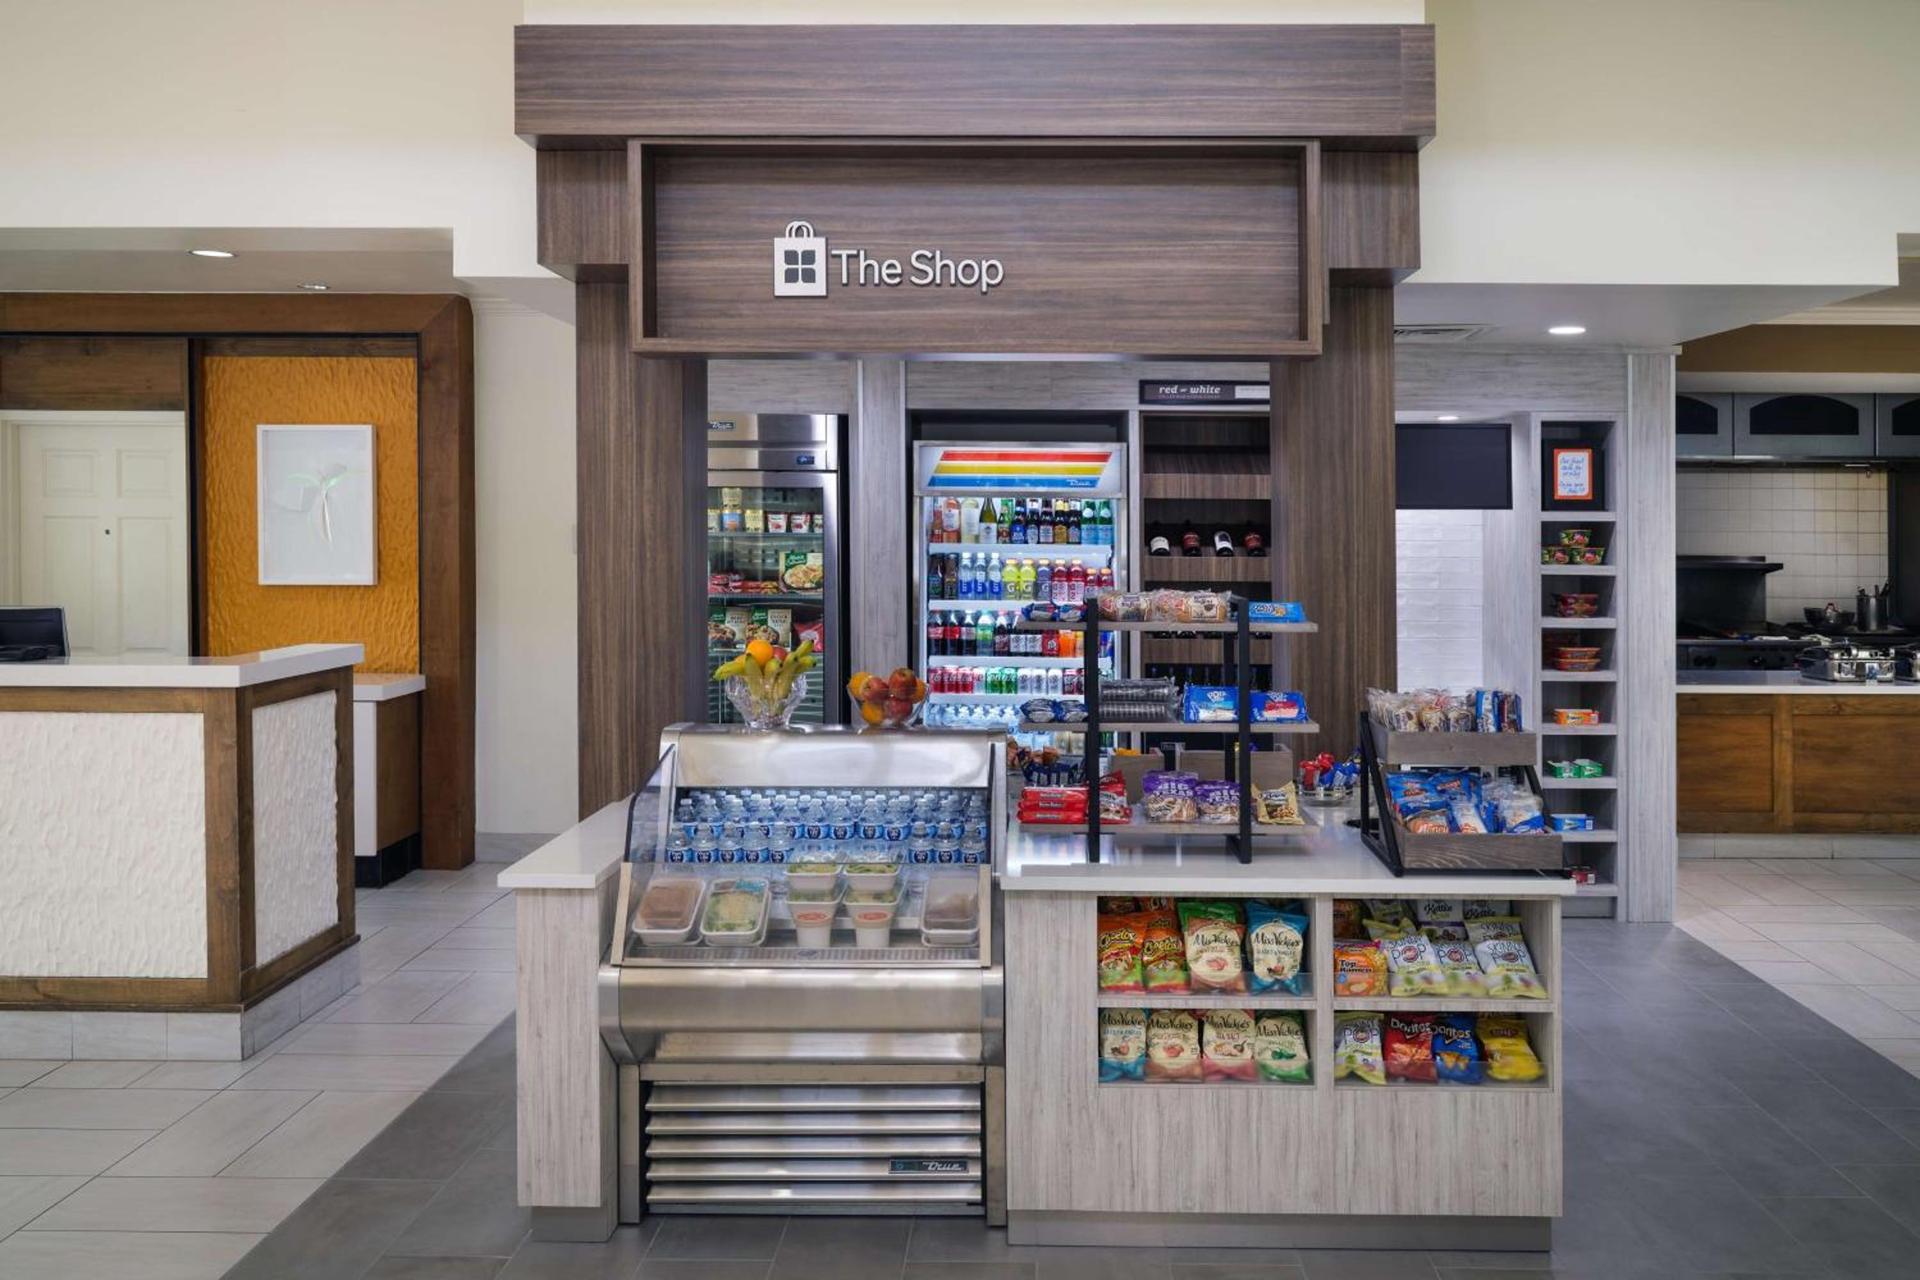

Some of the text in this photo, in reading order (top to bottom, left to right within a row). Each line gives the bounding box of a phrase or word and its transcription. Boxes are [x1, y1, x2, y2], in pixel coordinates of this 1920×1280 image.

[831, 249, 1004, 293] The Shop
[1159, 385, 1178, 394] red
[1190, 385, 1221, 394] white
[1339, 960, 1356, 969] Top
[1391, 1018, 1432, 1034] Doritos
[922, 1161, 962, 1171] True
